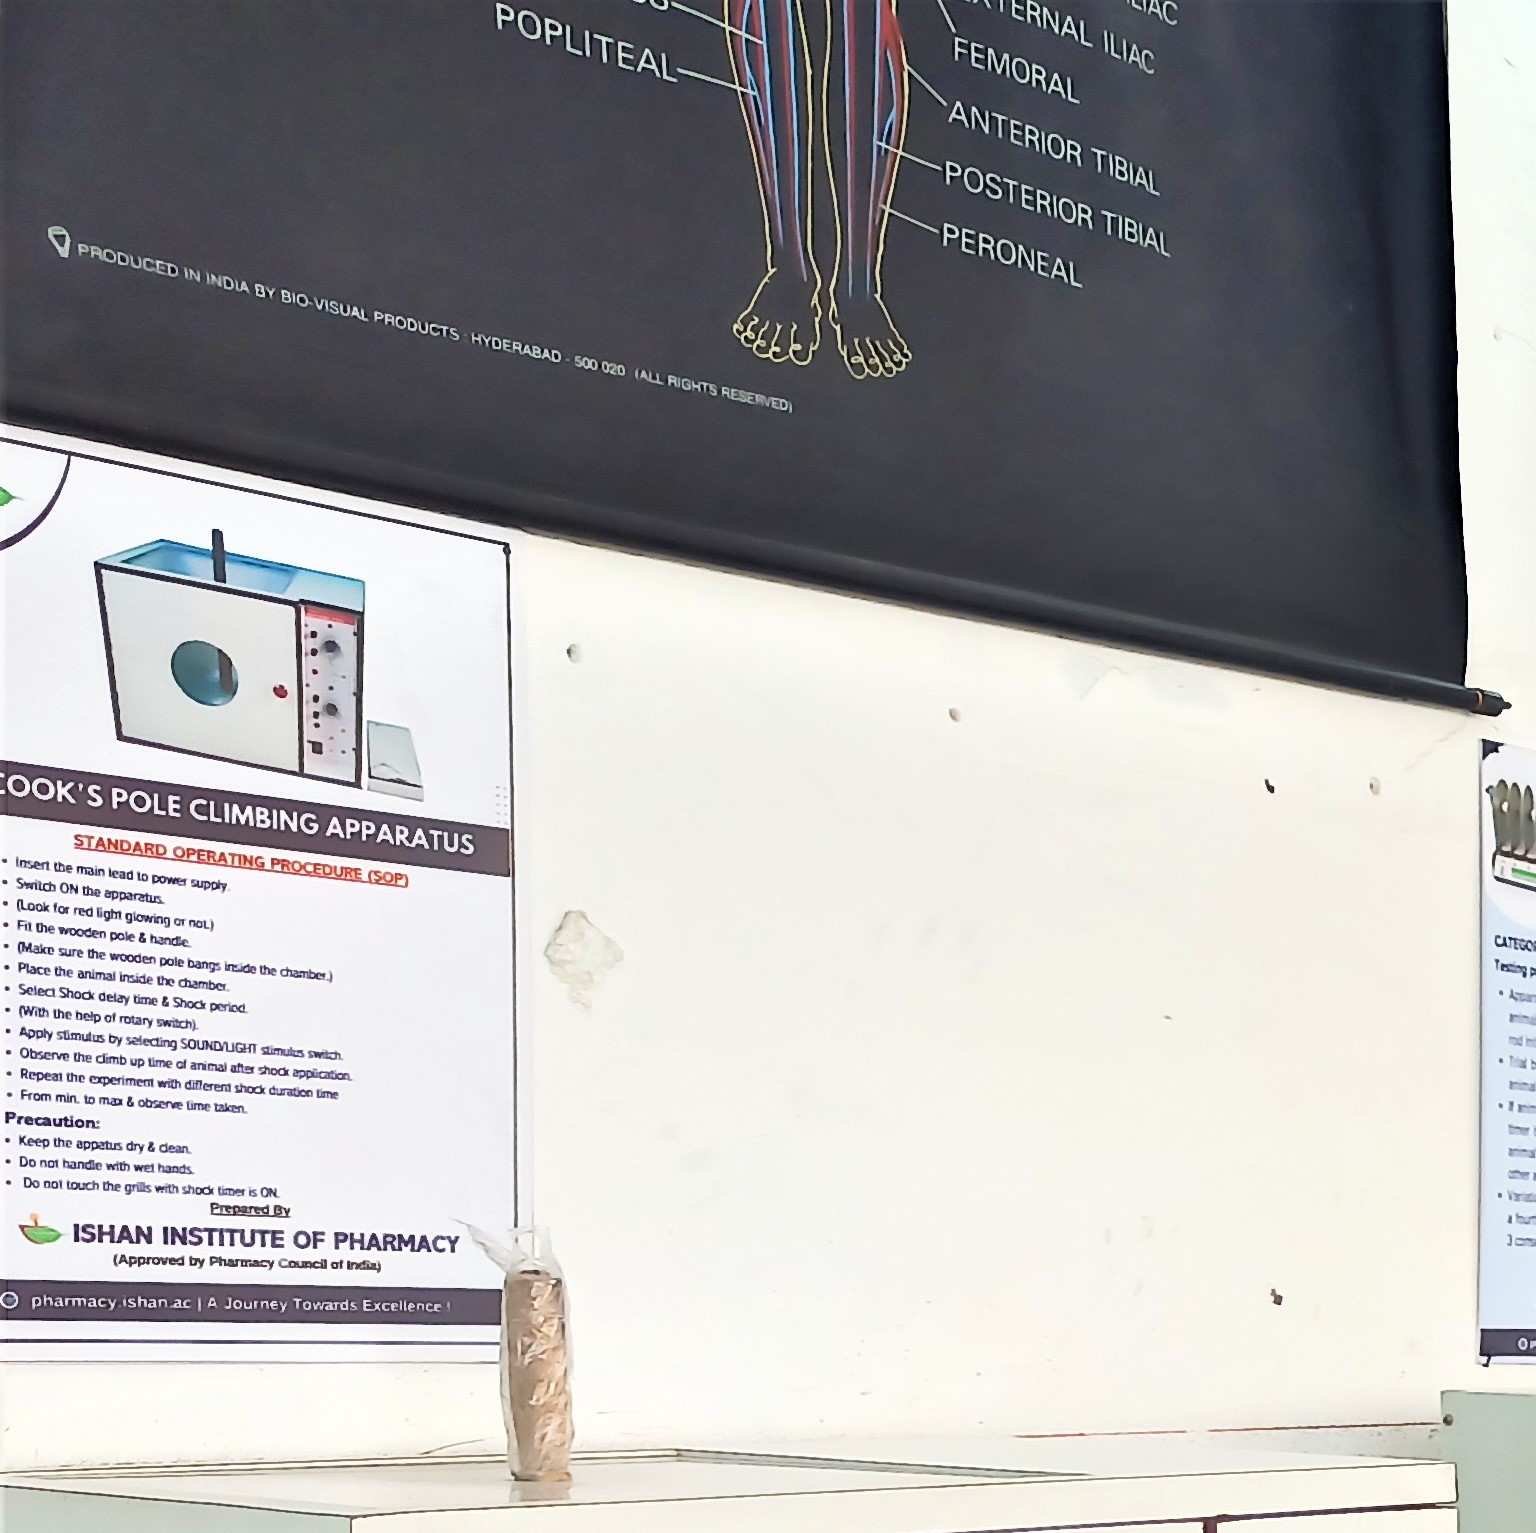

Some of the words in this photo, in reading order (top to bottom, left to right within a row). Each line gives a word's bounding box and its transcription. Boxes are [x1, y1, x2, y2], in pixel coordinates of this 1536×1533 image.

[1127, 0, 1178, 26] IAC
[496, 4, 678, 82] POPLITEAL
[963, 0, 1094, 48] ERNAL
[1104, 33, 1154, 74] ILIAC
[954, 38, 1080, 104] FEMORAL
[948, 105, 1081, 167] ANTERIOR
[1091, 150, 1160, 196] TIBIAL
[946, 162, 1093, 230] POSTERIOR
[1101, 213, 1171, 258] TIBIAL
[943, 223, 1083, 288] PERONEAL
[78, 243, 179, 277] PRODUCED
[184, 267, 200, 282] IN
[206, 272, 250, 293] INDIA
[255, 283, 275, 299] BY
[281, 289, 369, 322] BIO-VISUAL
[374, 311, 460, 340] PRODUCTS
[471, 332, 561, 362] HYDERABAD
[575, 356, 598, 370] 500
[668, 375, 717, 396] RIGHTS
[112, 788, 181, 817] POLE
[189, 799, 319, 834] CLIMBING
[325, 816, 473, 855] APPARATUS
[16, 856, 50, 871] Insert
[54, 861, 73, 874] the
[76, 866, 105, 877] main
[108, 867, 134, 880] lead
[137, 871, 149, 882] to
[152, 874, 187, 886] power
[74, 834, 167, 856] STANDARD
[173, 846, 265, 868] OPERATING
[270, 857, 362, 879] PROCEDURE
[368, 870, 409, 884] (SOP)
[16, 877, 56, 892] Switch
[59, 882, 79, 894] ON
[82, 885, 101, 897] the
[53, 902, 70, 915] for
[73, 907, 93, 917] red
[96, 907, 122, 922] light
[125, 912, 171, 928] glowing
[173, 918, 186, 926] or
[17, 919, 32, 932] Fit
[35, 922, 55, 934] the
[58, 926, 106, 939] wooden
[110, 931, 136, 942] pole
[138, 932, 147, 943] &
[18, 962, 51, 976] Place
[54, 966, 74, 978] the
[77, 969, 116, 981] animal
[119, 971, 153, 985] inside
[157, 975, 175, 987] the
[18, 983, 56, 998] Select
[59, 987, 95, 1001] Shock
[98, 992, 130, 1006] delay
[133, 994, 158, 1006] time
[161, 996, 169, 1007] &
[173, 997, 206, 1010] Shock
[53, 1008, 72, 1020] the
[75, 1010, 101, 1024] help
[104, 1012, 116, 1023] of
[119, 1015, 153, 1029] rotary
[5, 1111, 100, 1129] Precaution:
[19, 1156, 37, 1168] Do
[40, 1159, 59, 1169] not
[62, 1158, 102, 1171] handle
[105, 1161, 130, 1172] with
[133, 1163, 155, 1173] wet
[210, 1202, 270, 1217] Prepared
[273, 1204, 291, 1218] By
[73, 1223, 153, 1245] ISHAN
[162, 1226, 285, 1248] INSTITUTE
[293, 1230, 326, 1249] OF
[333, 1232, 460, 1253] PHARMACY
[113, 1254, 185, 1268] (Approved
[189, 1255, 205, 1269] by
[209, 1256, 275, 1271] Pharmacy
[278, 1258, 328, 1269] Council
[330, 1259, 344, 1270] of
[208, 1297, 218, 1308] A
[224, 1297, 287, 1313] Journey
[292, 1298, 358, 1311] Towards
[363, 1299, 442, 1312] Excellence
